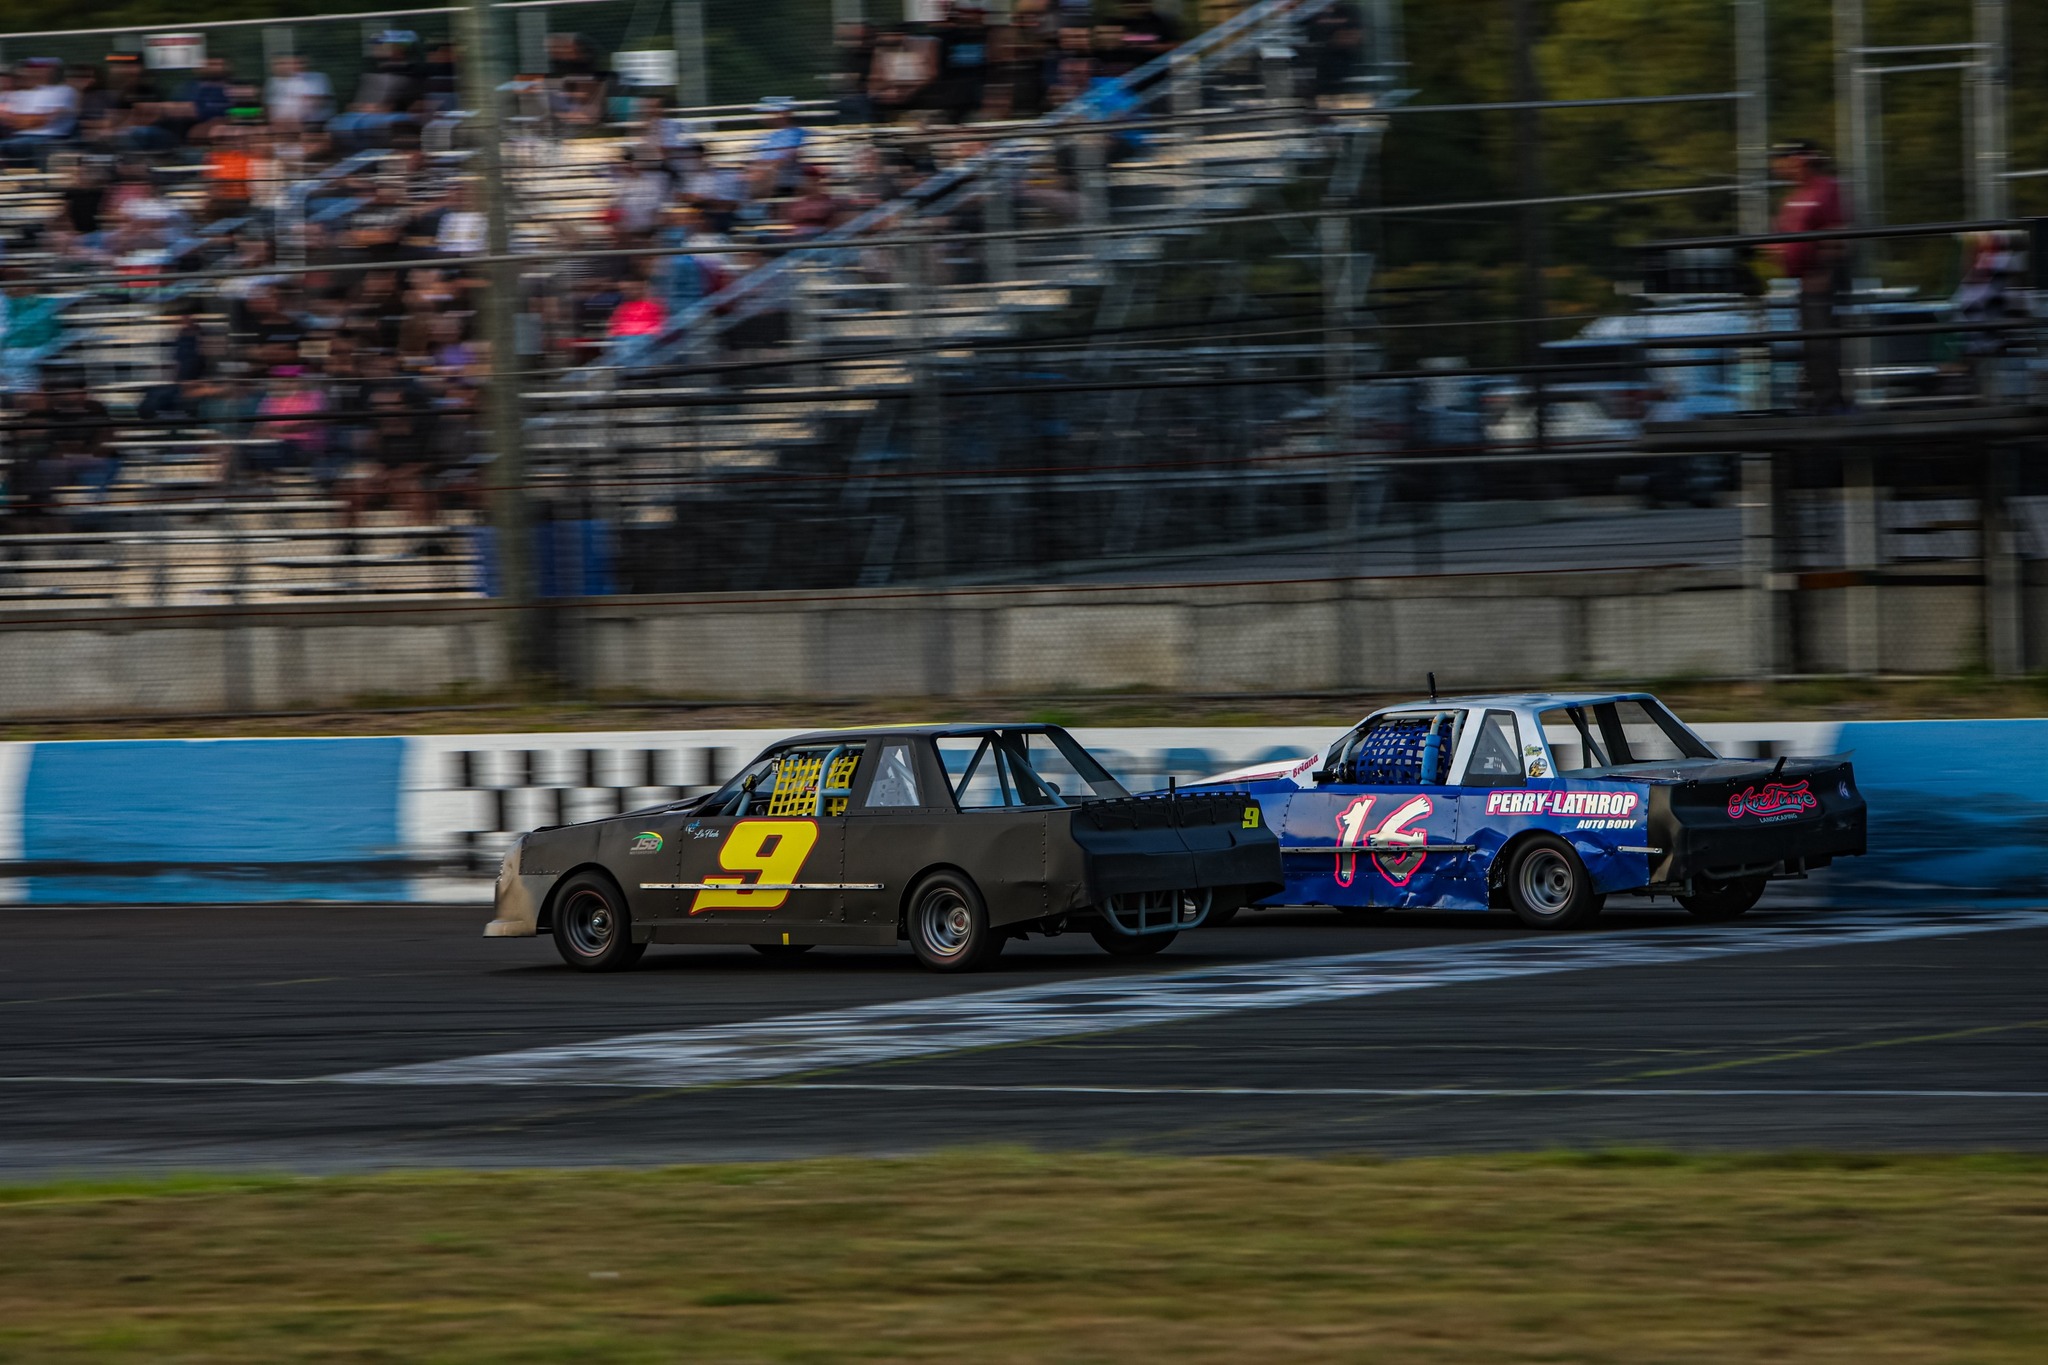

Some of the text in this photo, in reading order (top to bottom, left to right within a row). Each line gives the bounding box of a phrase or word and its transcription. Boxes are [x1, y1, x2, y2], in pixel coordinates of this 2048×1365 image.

[1292, 753, 1319, 778] Briana
[1838, 781, 1850, 799] 16
[1486, 792, 1637, 816] PERRY-LATHROP
[1243, 807, 1260, 829] 9
[1575, 819, 1637, 830] AUTO BODY
[1758, 813, 1798, 824] LANDSCAPING
[630, 838, 660, 851] JSB
[1336, 792, 1432, 886] 16
[689, 818, 820, 915] 9
